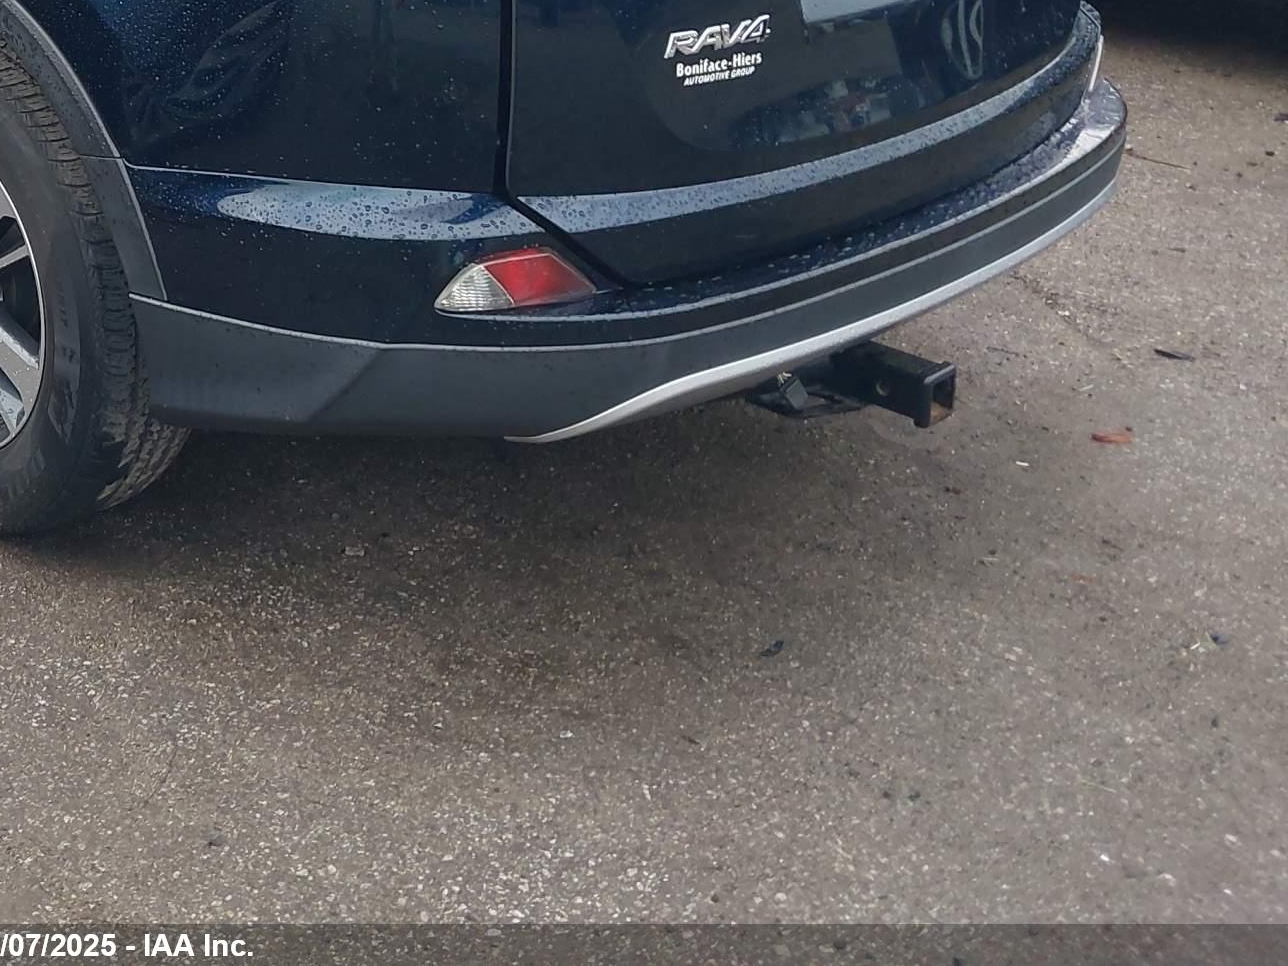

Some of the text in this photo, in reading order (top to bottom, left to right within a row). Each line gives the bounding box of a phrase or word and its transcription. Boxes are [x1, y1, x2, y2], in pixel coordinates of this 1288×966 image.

[664, 14, 771, 59] RAV4
[676, 52, 762, 78] Boniface-Hiers
[683, 66, 756, 87] AUTOMOTIVE GROUP
